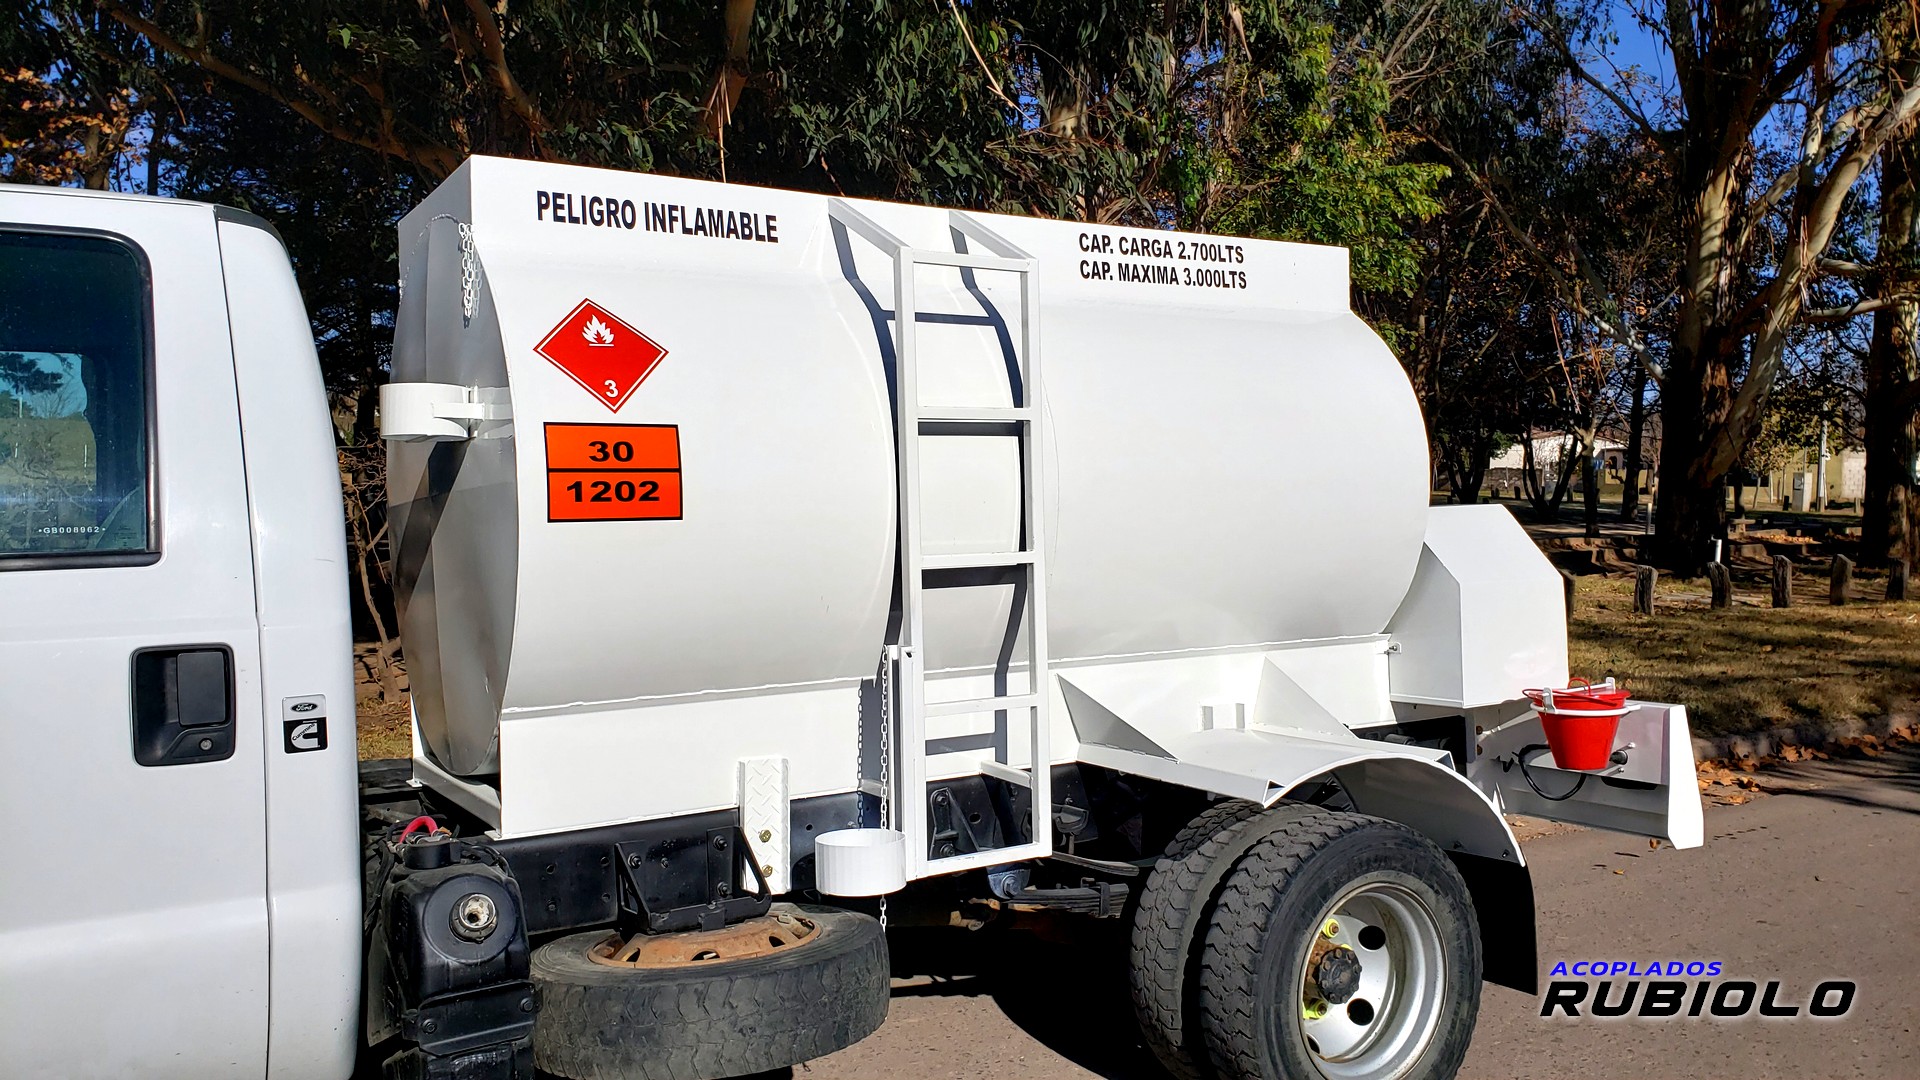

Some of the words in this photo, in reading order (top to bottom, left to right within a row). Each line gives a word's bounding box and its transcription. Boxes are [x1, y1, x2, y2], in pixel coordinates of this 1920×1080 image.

[536, 190, 637, 230] PELIGRO
[644, 202, 779, 243] INFLAMABLE
[1078, 232, 1114, 254] CAP.
[1118, 236, 1174, 259] CARGA
[1177, 241, 1244, 264] 2.700LTS
[1079, 260, 1114, 281] CAP.
[1118, 263, 1180, 285] MAXIMA
[1183, 267, 1247, 289] 3.000LTS
[604, 379, 619, 398] 3
[588, 440, 634, 462] 30
[566, 480, 660, 503] 1202
